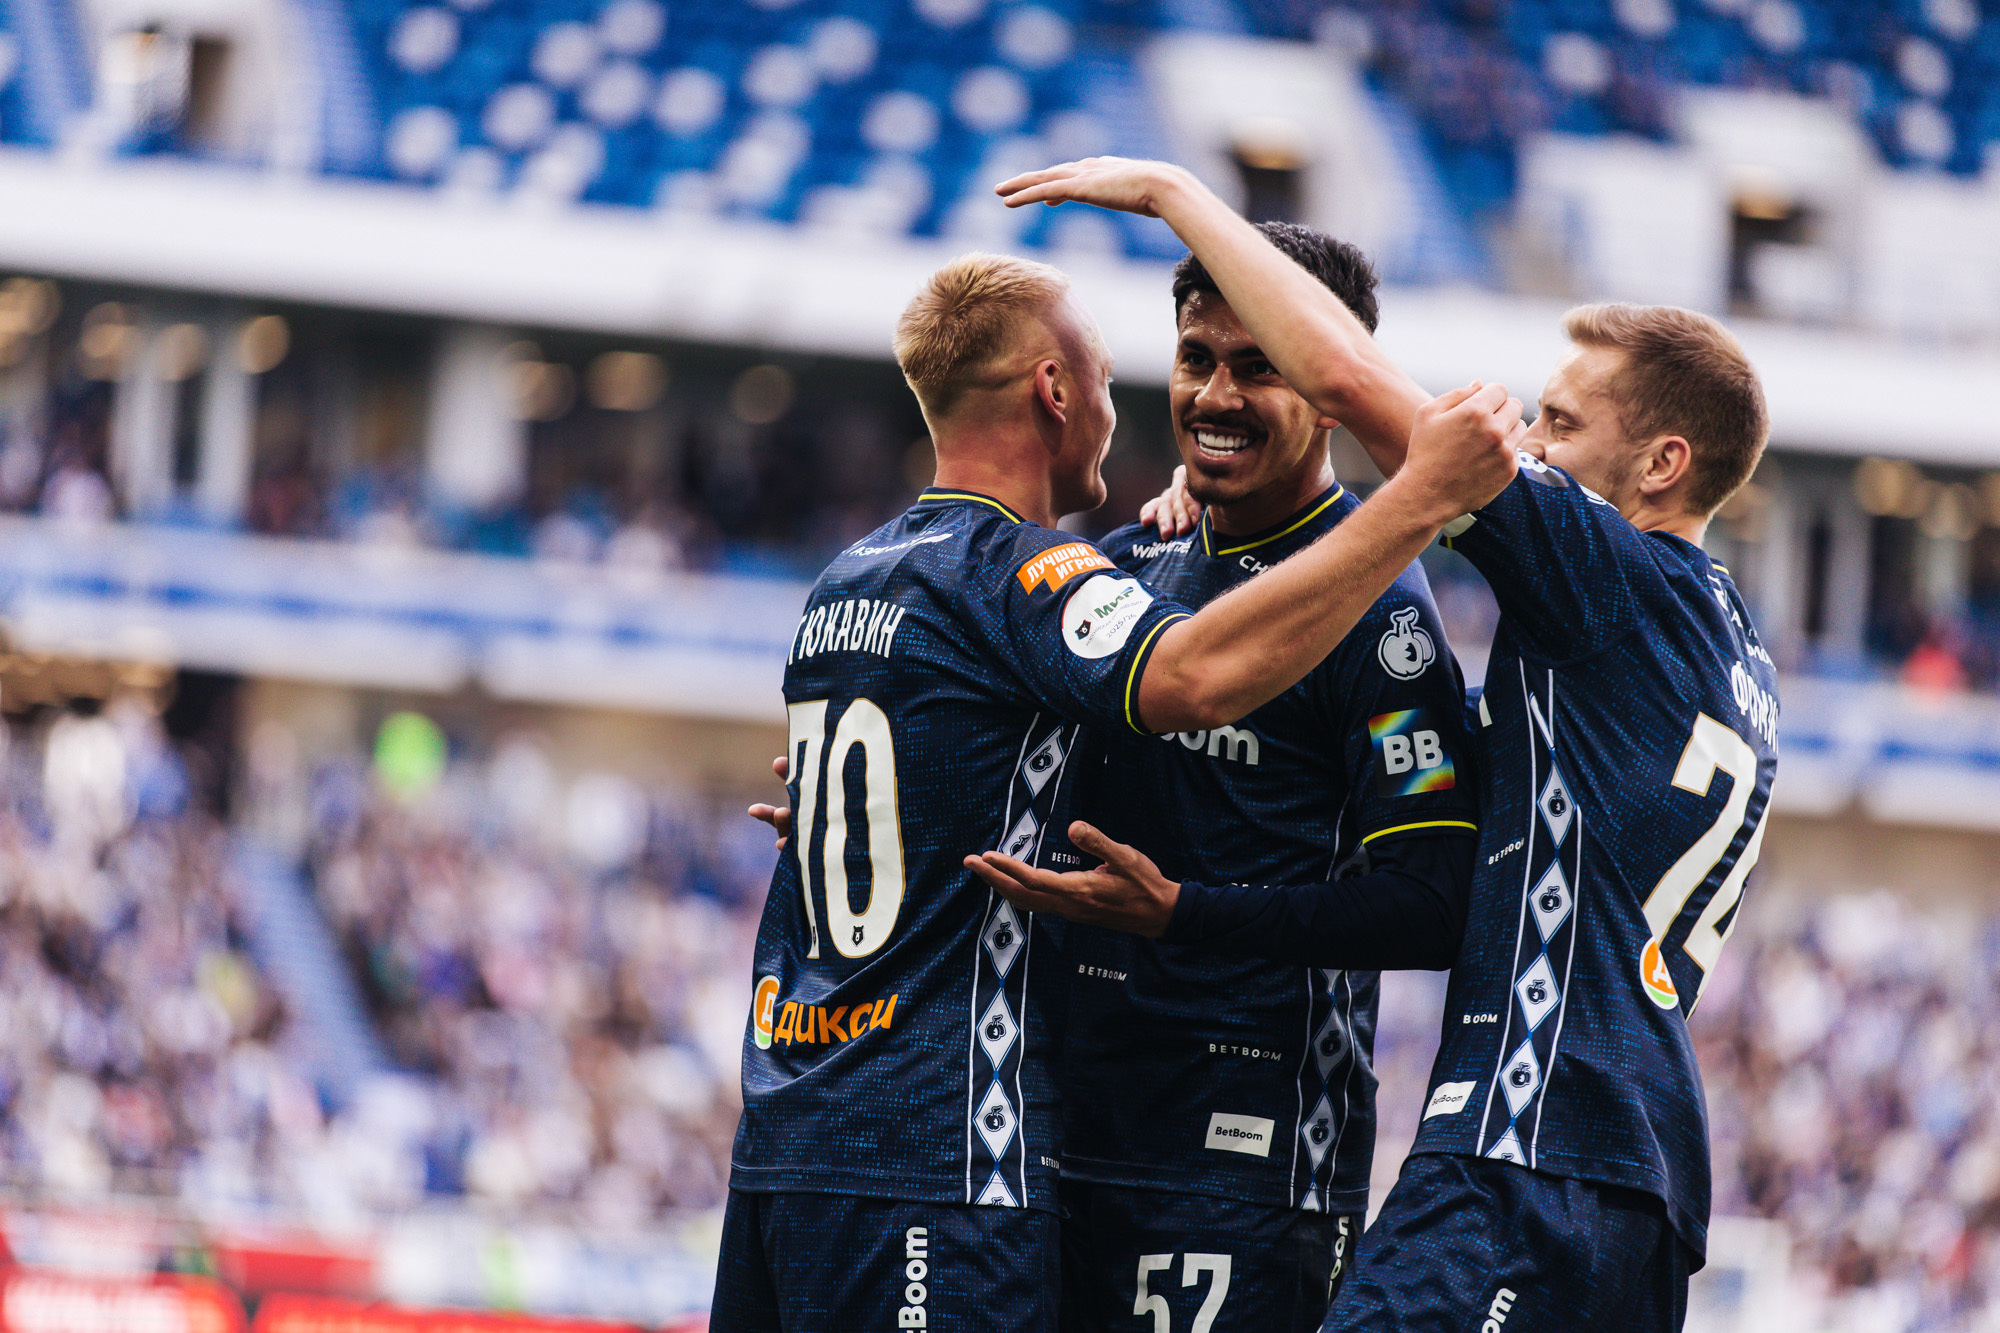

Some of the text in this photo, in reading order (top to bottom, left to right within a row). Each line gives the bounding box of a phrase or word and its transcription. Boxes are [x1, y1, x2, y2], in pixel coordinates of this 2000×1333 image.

[1026, 544, 1090, 583] ЛУЧШИЙ
[1055, 556, 1106, 580] ИГРОК
[1731, 660, 1779, 757] ФОМИ
[1160, 725, 1259, 765] om
[1383, 730, 1443, 775] BB
[785, 697, 906, 959] 70
[1051, 852, 1081, 865] BETBOO
[1078, 964, 1127, 981] BETBOOM
[1463, 1013, 1498, 1024] BOOM
[1209, 1043, 1281, 1061] BETBOOM
[1215, 1126, 1263, 1142] BetBoom
[898, 1226, 928, 1333] Boom
[1133, 1252, 1232, 1333] 57
